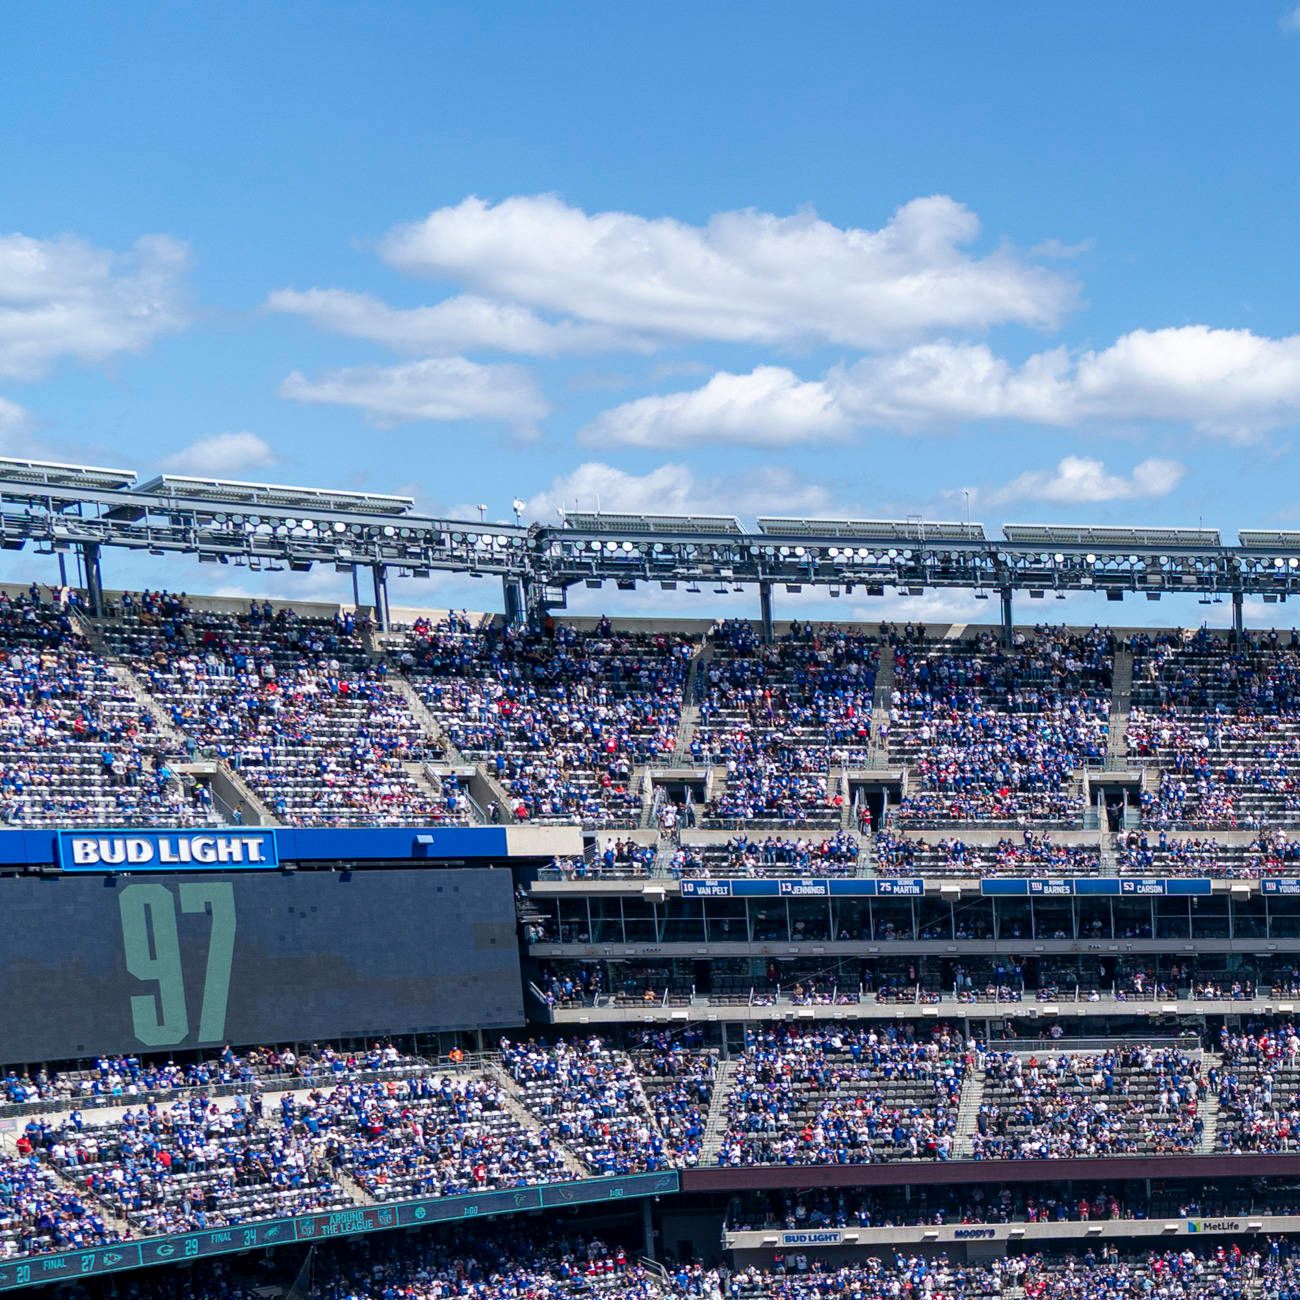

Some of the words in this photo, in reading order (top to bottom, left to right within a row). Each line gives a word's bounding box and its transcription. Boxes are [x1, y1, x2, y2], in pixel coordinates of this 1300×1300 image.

[72, 836, 155, 864] BUD
[683, 883, 694, 893] 10
[697, 886, 711, 895] VAN
[712, 886, 728, 895] PELT
[782, 883, 792, 892] 13
[791, 885, 826, 895] JENNINGS
[880, 883, 891, 892] 75
[893, 885, 920, 894] MARTIN
[1123, 882, 1134, 891] 53
[1136, 885, 1163, 894] CARSON
[118, 882, 237, 1047] 97
[321, 1223, 338, 1235] THE
[340, 1219, 373, 1233] LEAGUE
[1203, 1222, 1239, 1232] MetLife
[185, 1239, 199, 1255] 29
[211, 1233, 232, 1244] FINAL
[244, 1229, 257, 1246] 34
[785, 1234, 806, 1243] BUD
[807, 1233, 839, 1243] LIGHT
[16, 1265, 31, 1282] 20
[43, 1258, 66, 1271] FINAL
[81, 1255, 95, 1272] 27
